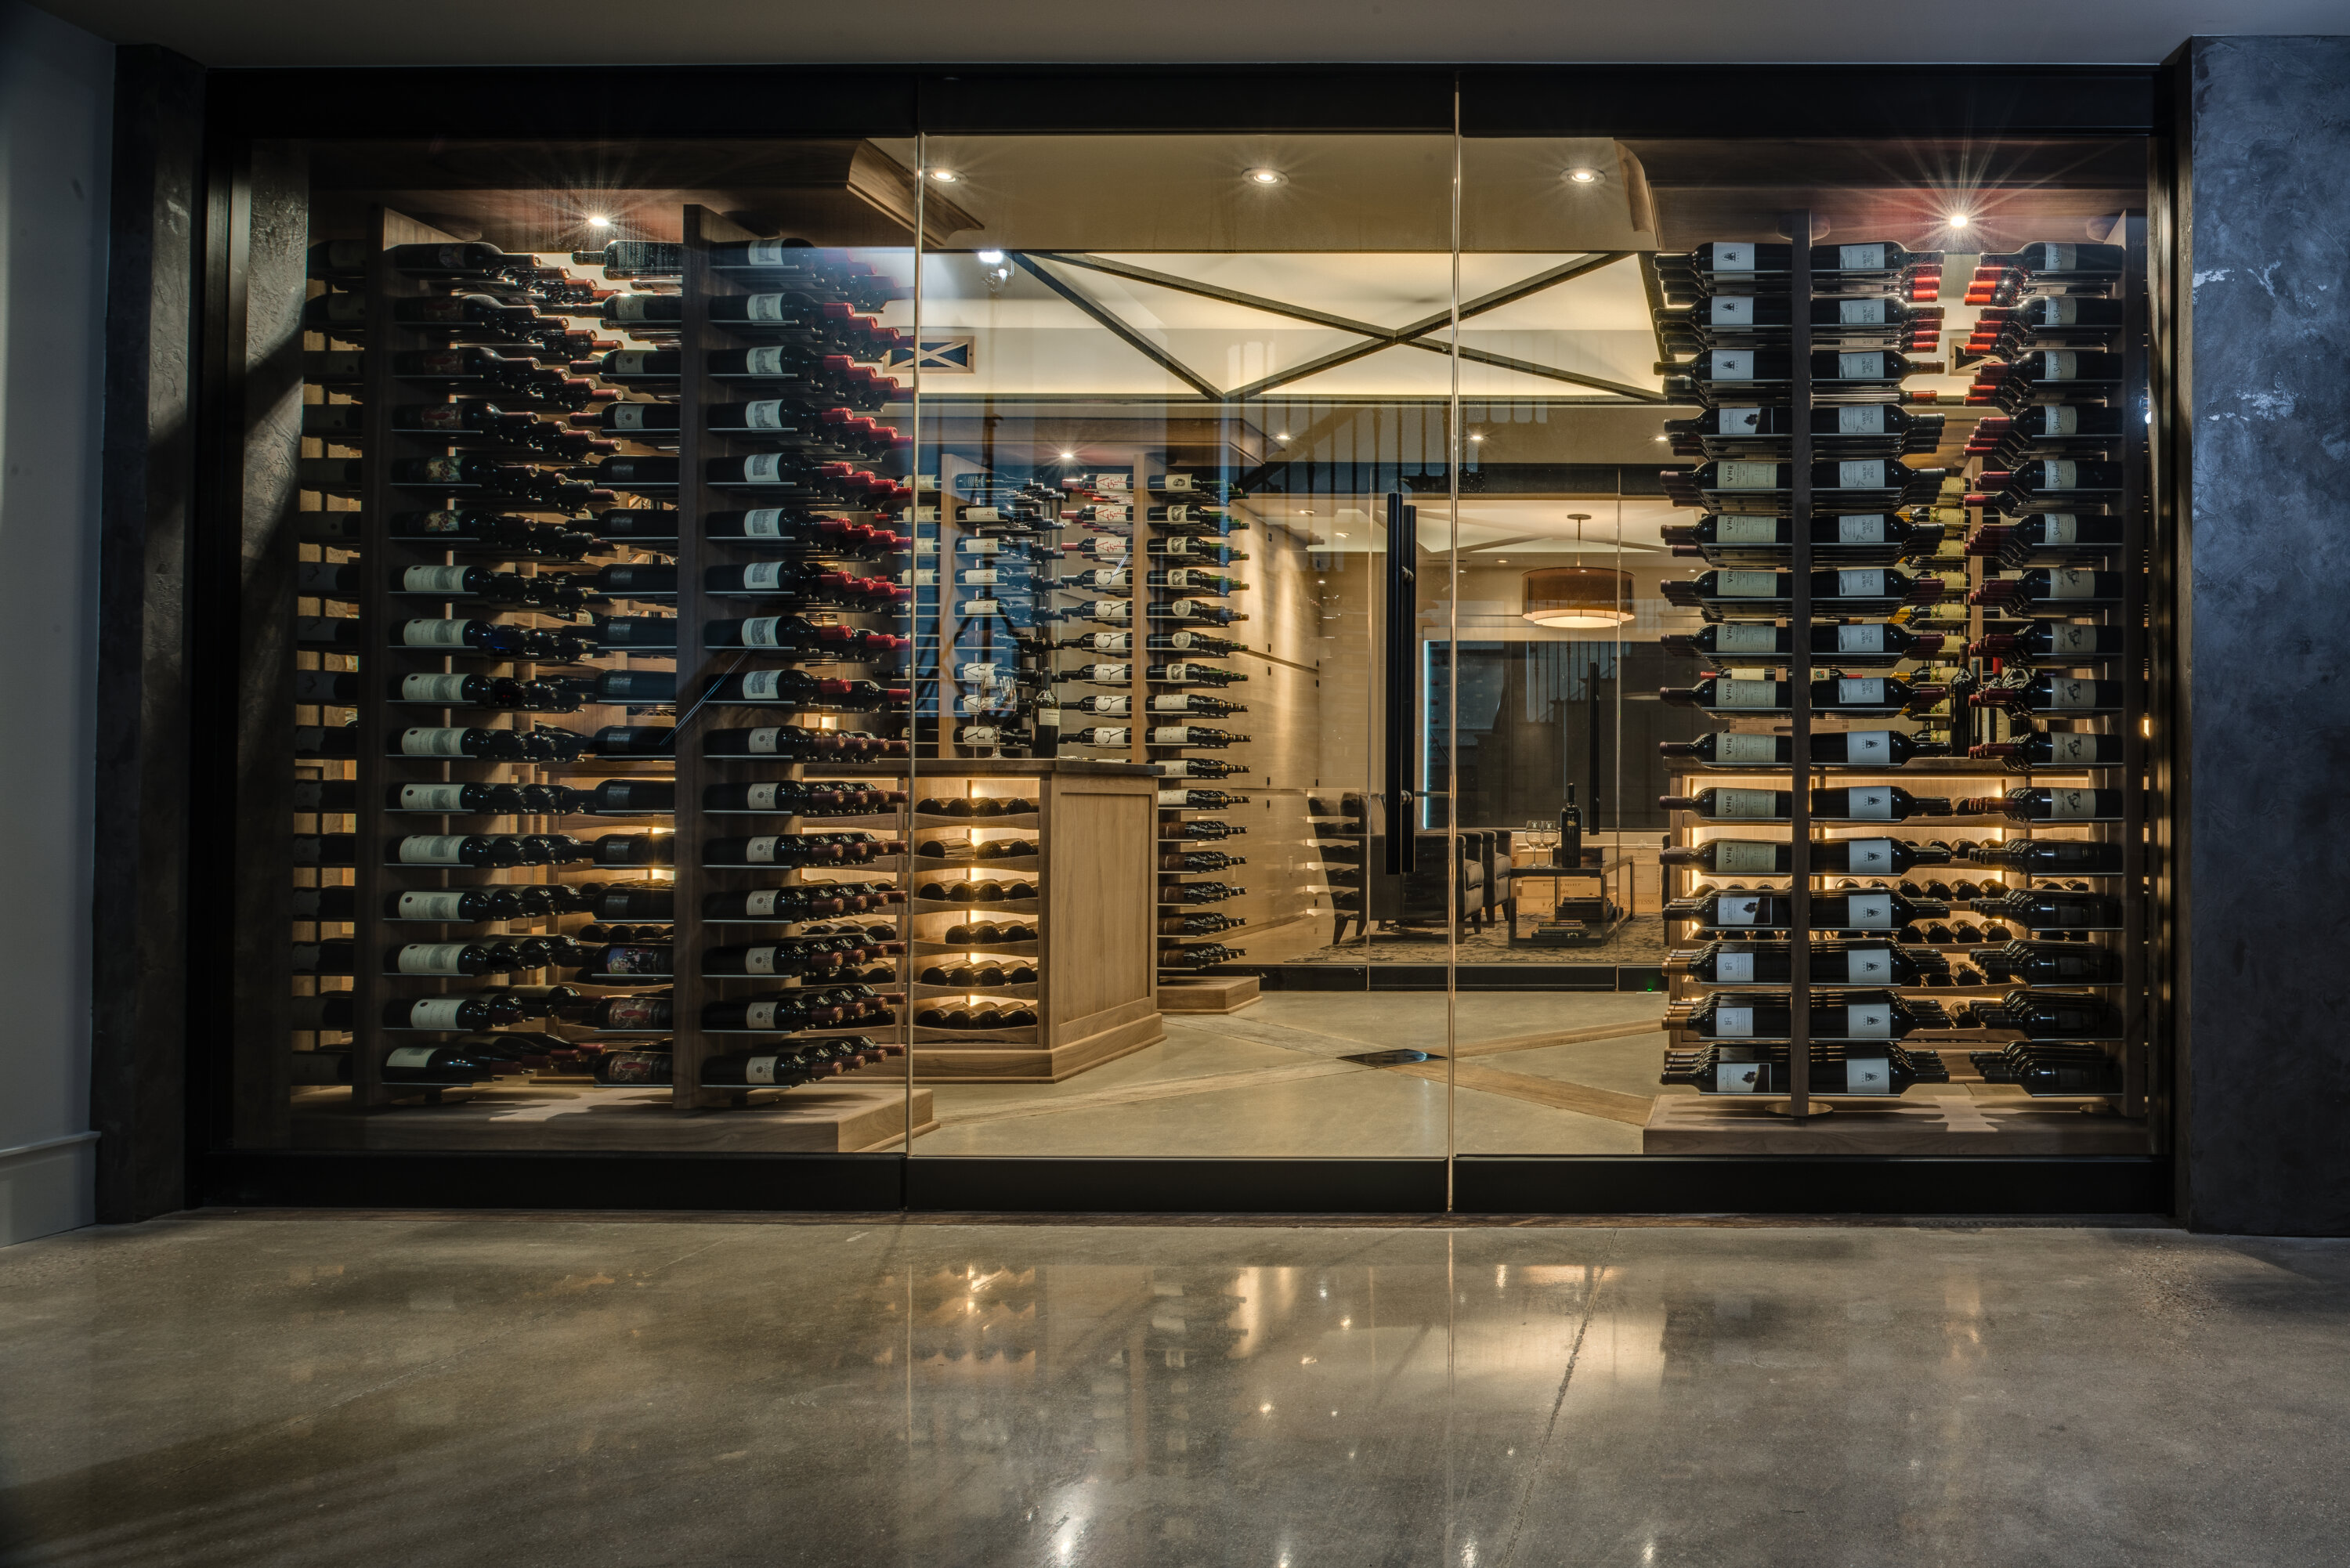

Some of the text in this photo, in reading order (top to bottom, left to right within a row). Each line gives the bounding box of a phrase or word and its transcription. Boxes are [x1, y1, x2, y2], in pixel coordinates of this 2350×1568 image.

[2052, 461, 2063, 485] Schrader
[2052, 514, 2063, 537] Schrader
[1619, 898, 1654, 909] QUTESSA
